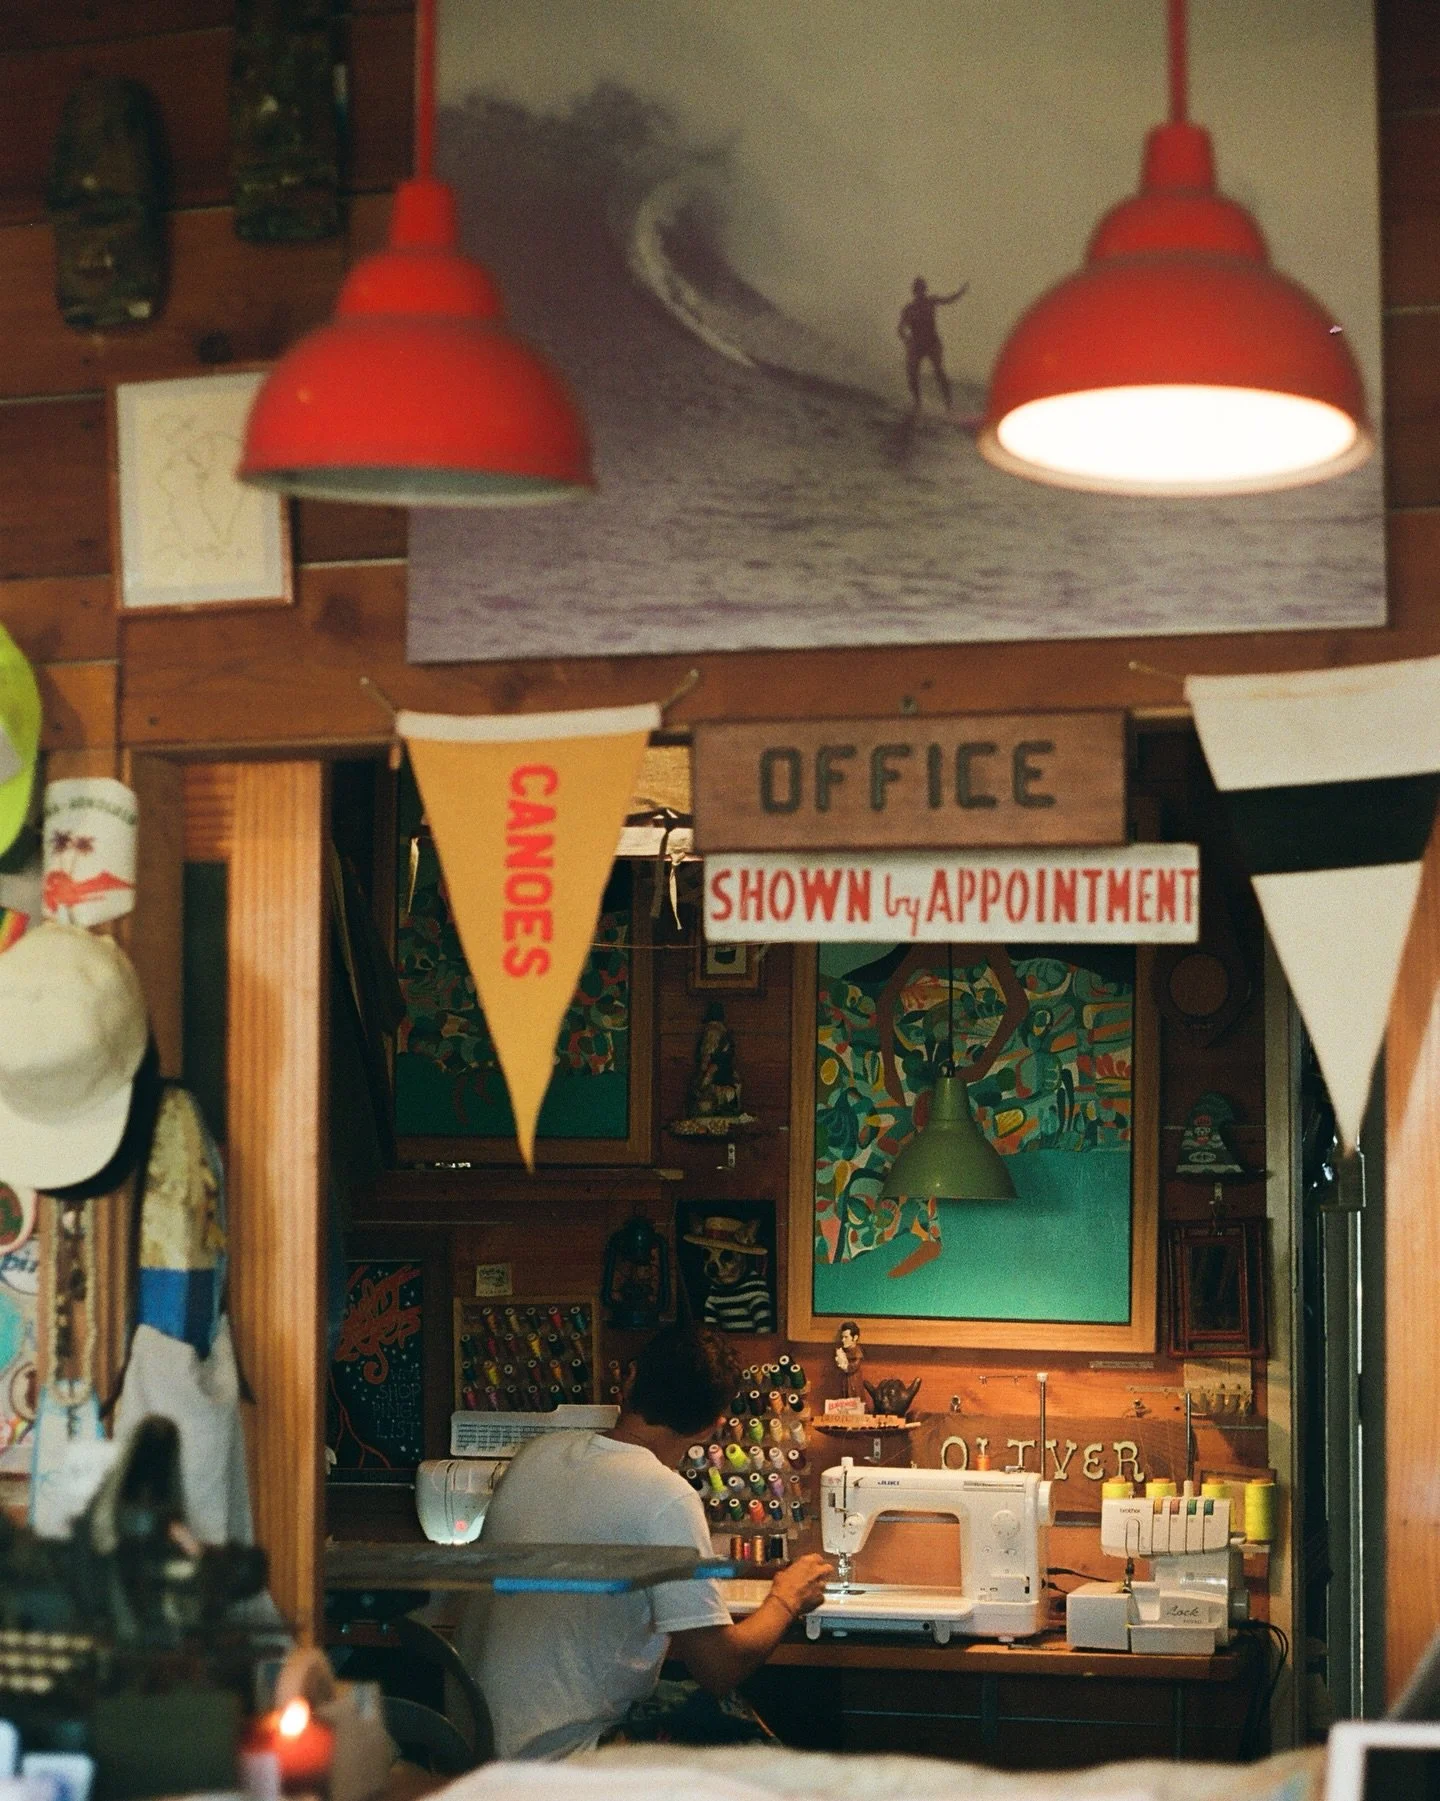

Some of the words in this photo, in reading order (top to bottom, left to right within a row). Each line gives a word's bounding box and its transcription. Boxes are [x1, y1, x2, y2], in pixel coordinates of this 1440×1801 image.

[759, 741, 1057, 814] OFFICE
[503, 764, 558, 978] CANOES
[710, 868, 872, 922] SHOWN
[884, 873, 920, 937] by
[926, 867, 1199, 924] APPOINTMENT
